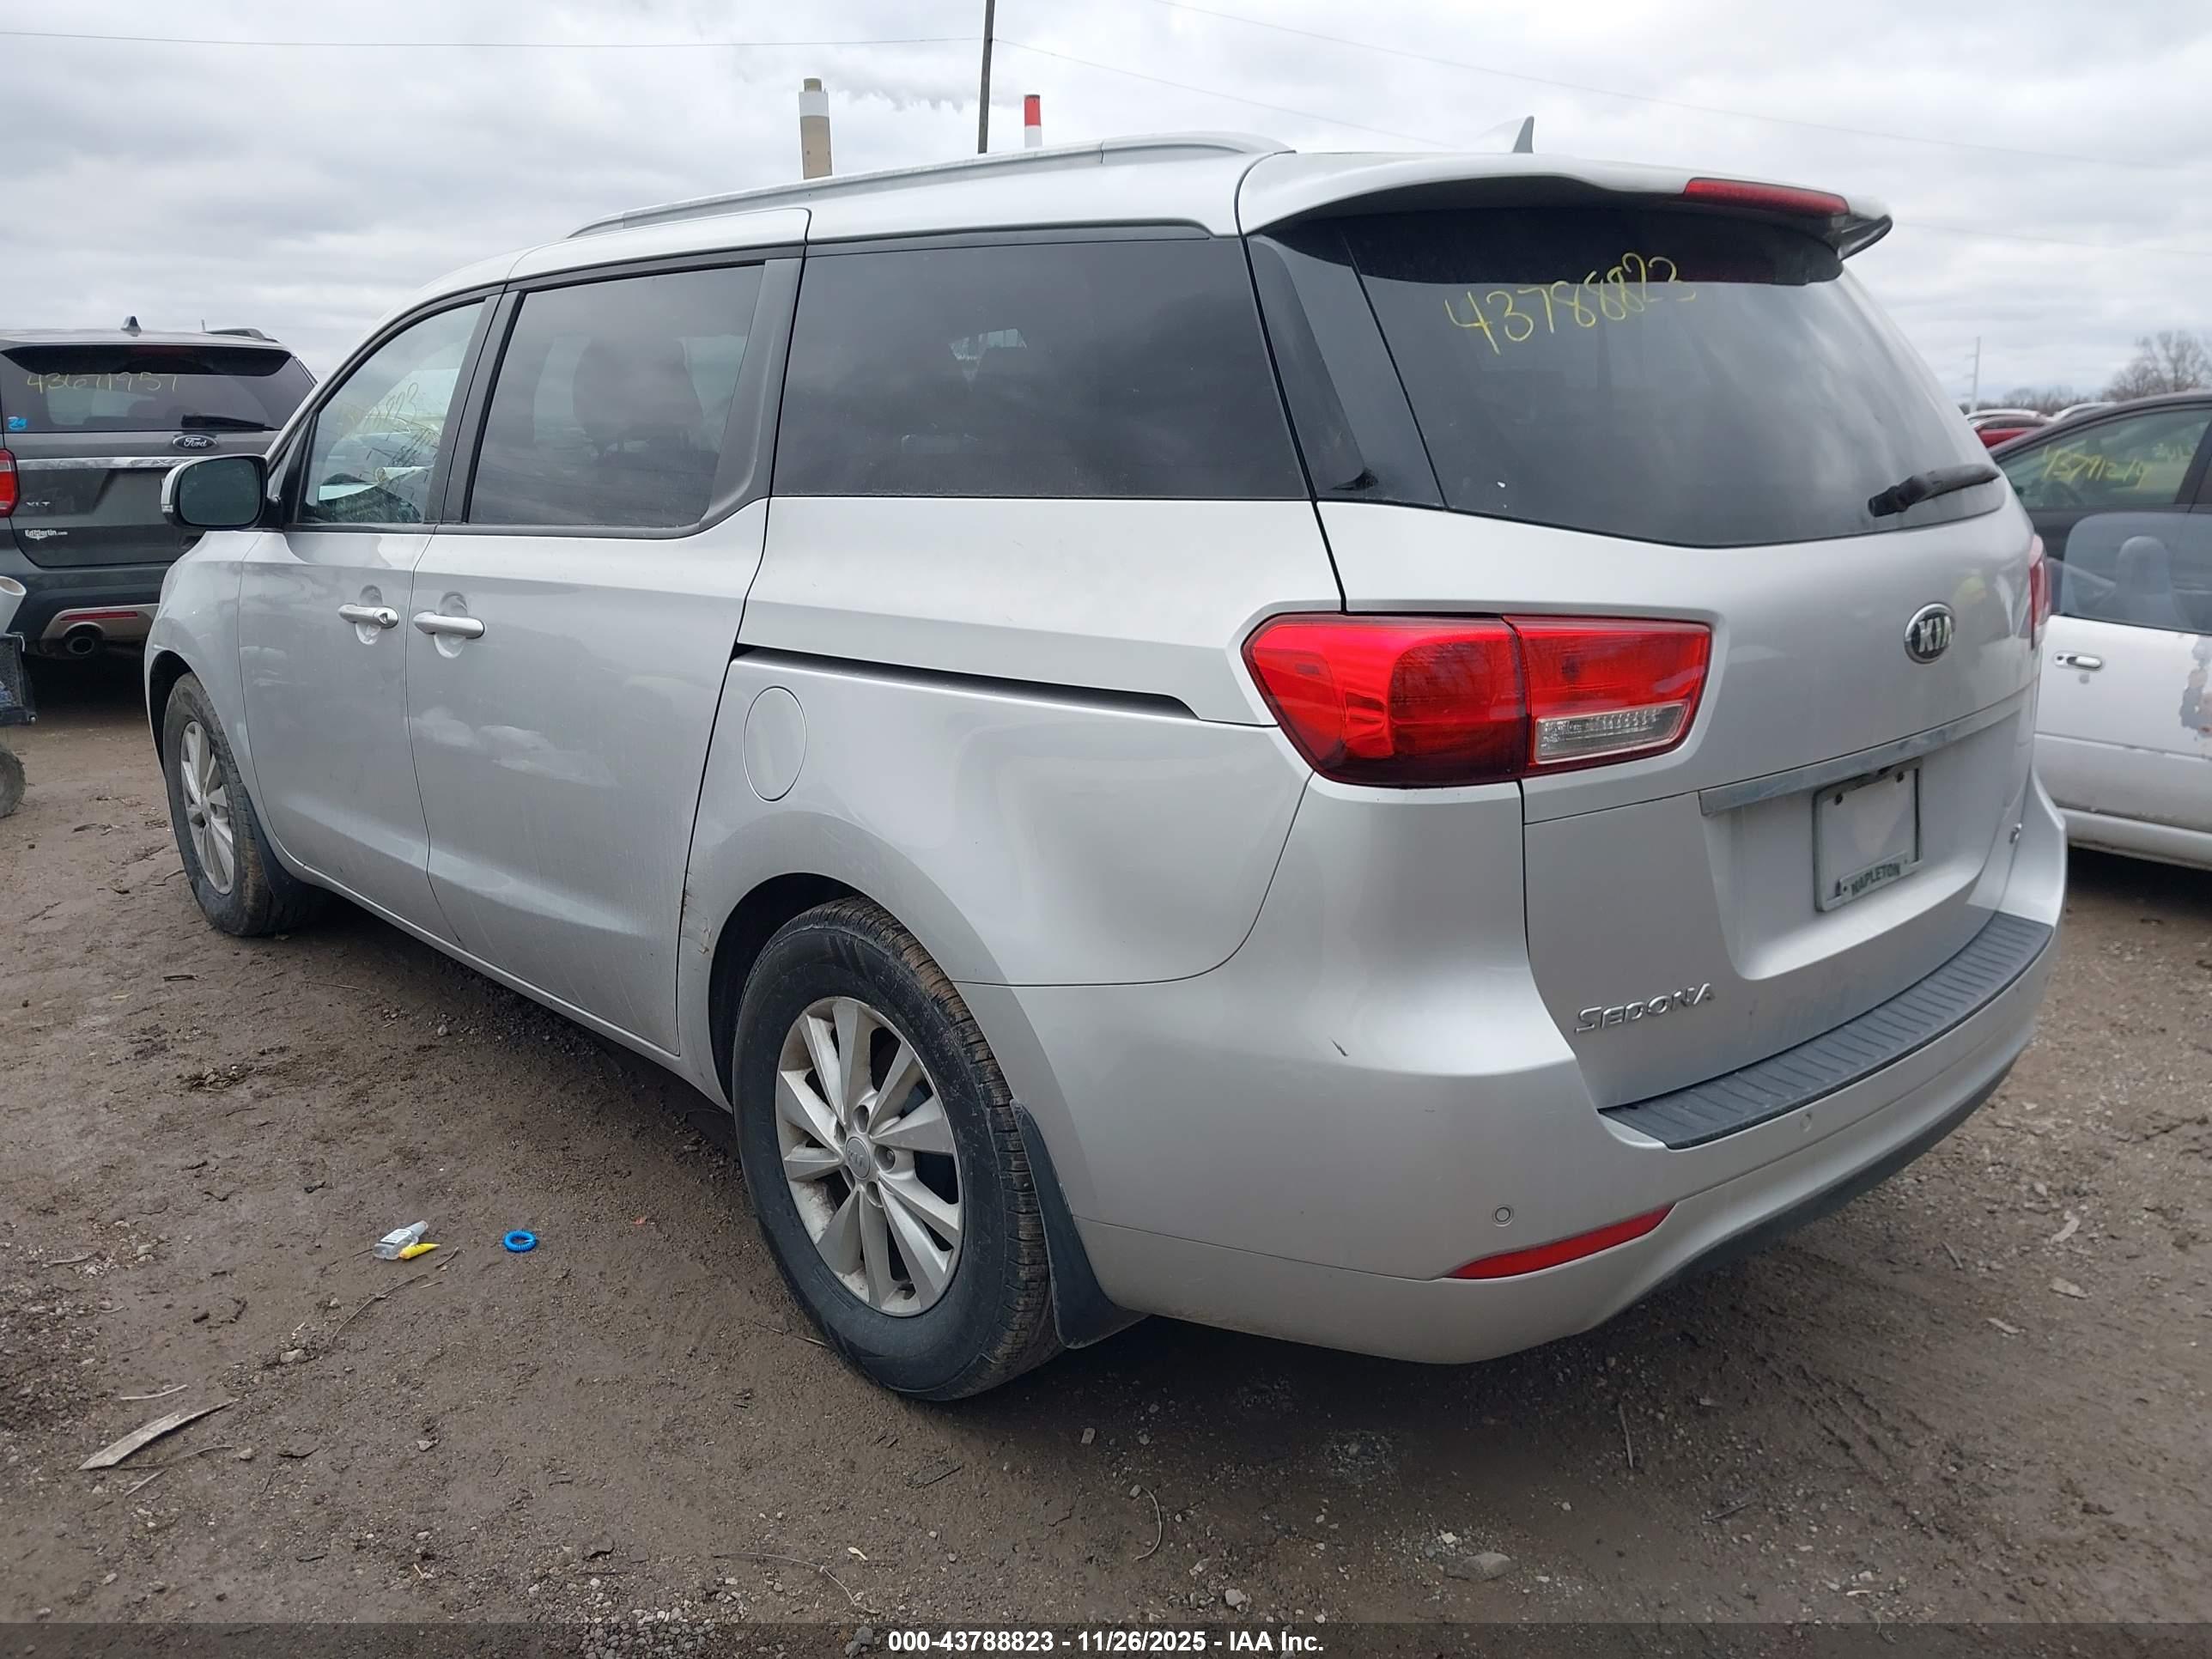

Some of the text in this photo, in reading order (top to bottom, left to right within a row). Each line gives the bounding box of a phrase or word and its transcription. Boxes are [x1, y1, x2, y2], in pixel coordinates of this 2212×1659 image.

[1443, 252, 1697, 356] 43788823
[183, 436, 207, 447] Ford
[1918, 615, 1952, 653] KIA
[1851, 862, 1900, 896] MAPLETON
[1575, 982, 1714, 1033] SEDONA
